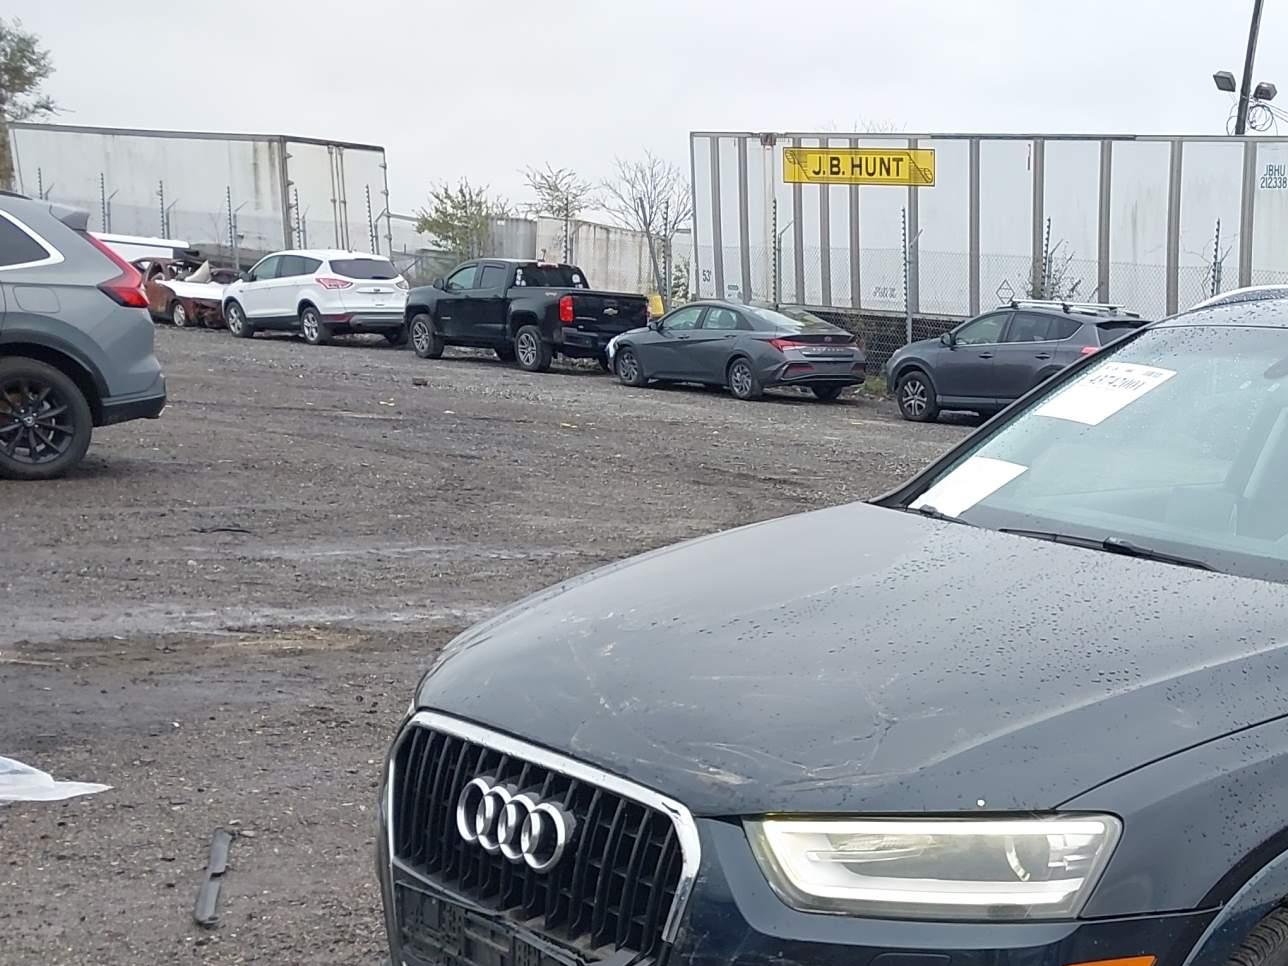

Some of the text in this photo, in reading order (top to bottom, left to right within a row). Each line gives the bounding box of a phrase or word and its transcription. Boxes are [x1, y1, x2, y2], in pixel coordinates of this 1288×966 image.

[851, 157, 904, 177] HUNT
[1264, 164, 1286, 176] JBHU
[1260, 176, 1288, 189] 212338
